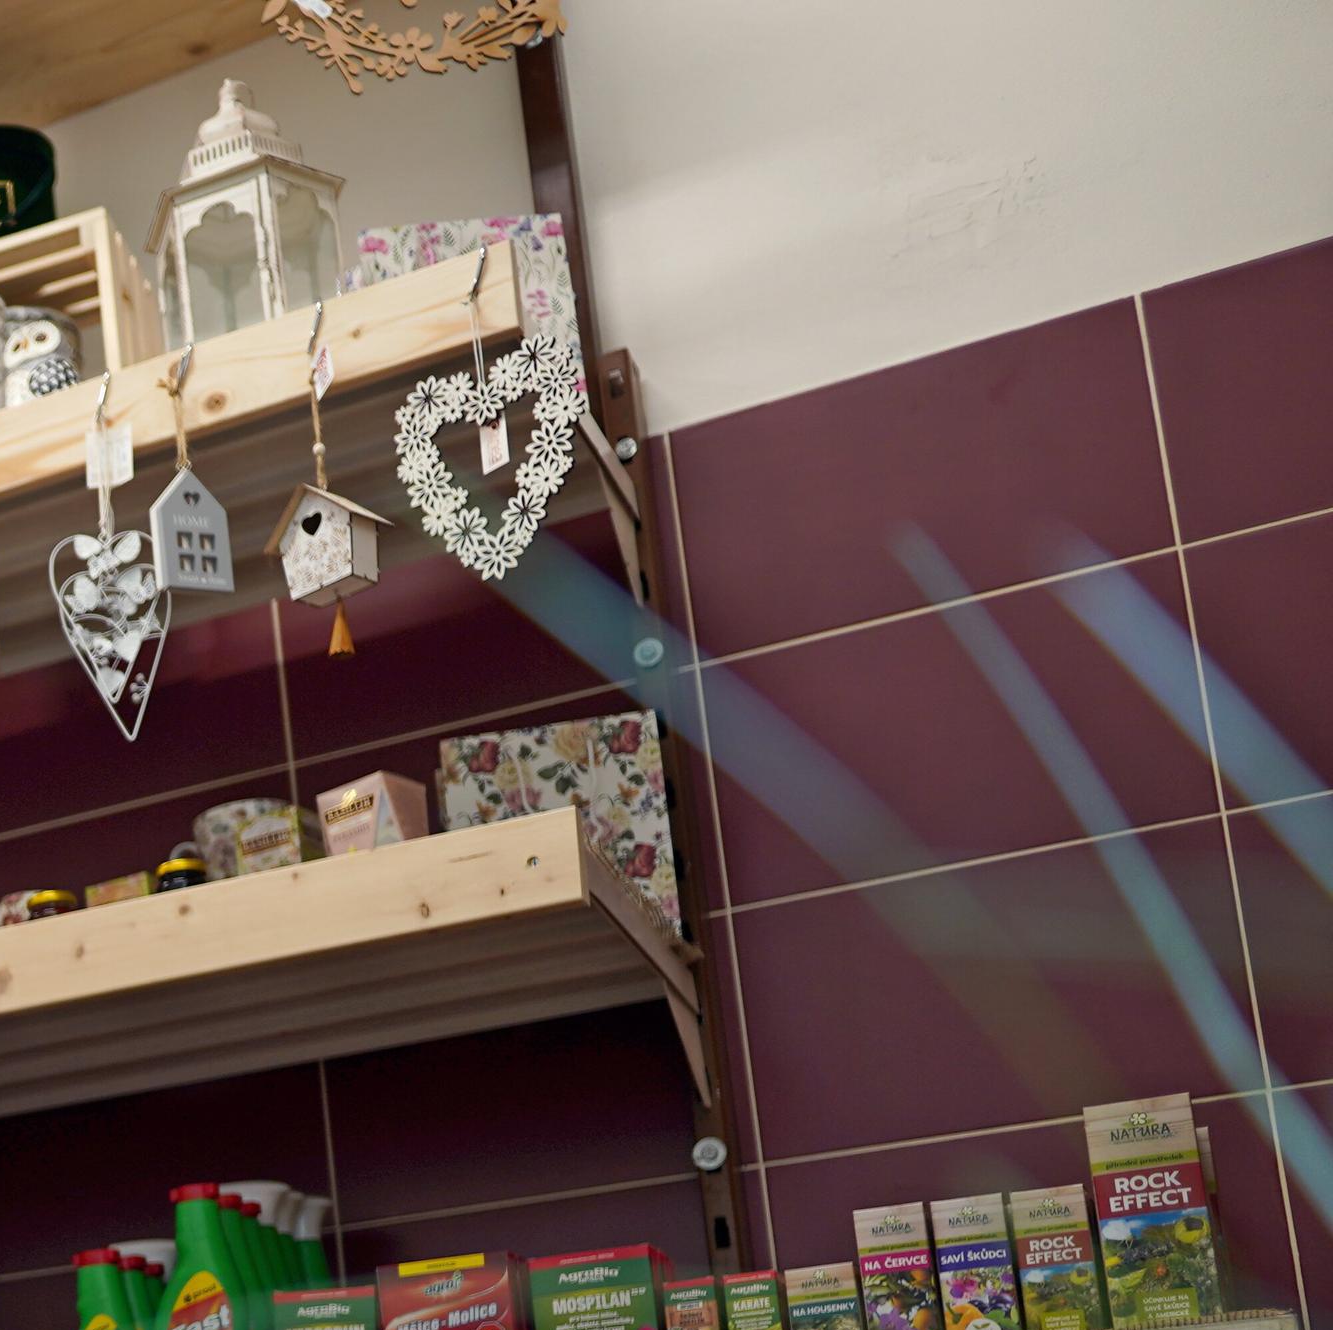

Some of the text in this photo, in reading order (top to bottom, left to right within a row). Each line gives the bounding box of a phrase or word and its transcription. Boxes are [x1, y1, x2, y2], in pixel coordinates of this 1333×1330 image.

[1110, 1122, 1171, 1142] NATURA
[1114, 1170, 1181, 1194] ROCK
[1109, 1187, 1192, 1213] EFFECT
[1029, 1235, 1074, 1252] ROCK
[864, 1254, 929, 1272] NA ČERVCE
[940, 1247, 1007, 1266] SAVÍ ŠKŮDCI
[1025, 1247, 1083, 1266] EFFECT
[552, 1289, 632, 1316] MOSPILAN
[733, 1296, 771, 1312] KARATE
[792, 1301, 855, 1318] NA HOUSENKY
[448, 1302, 498, 1328] Molice
